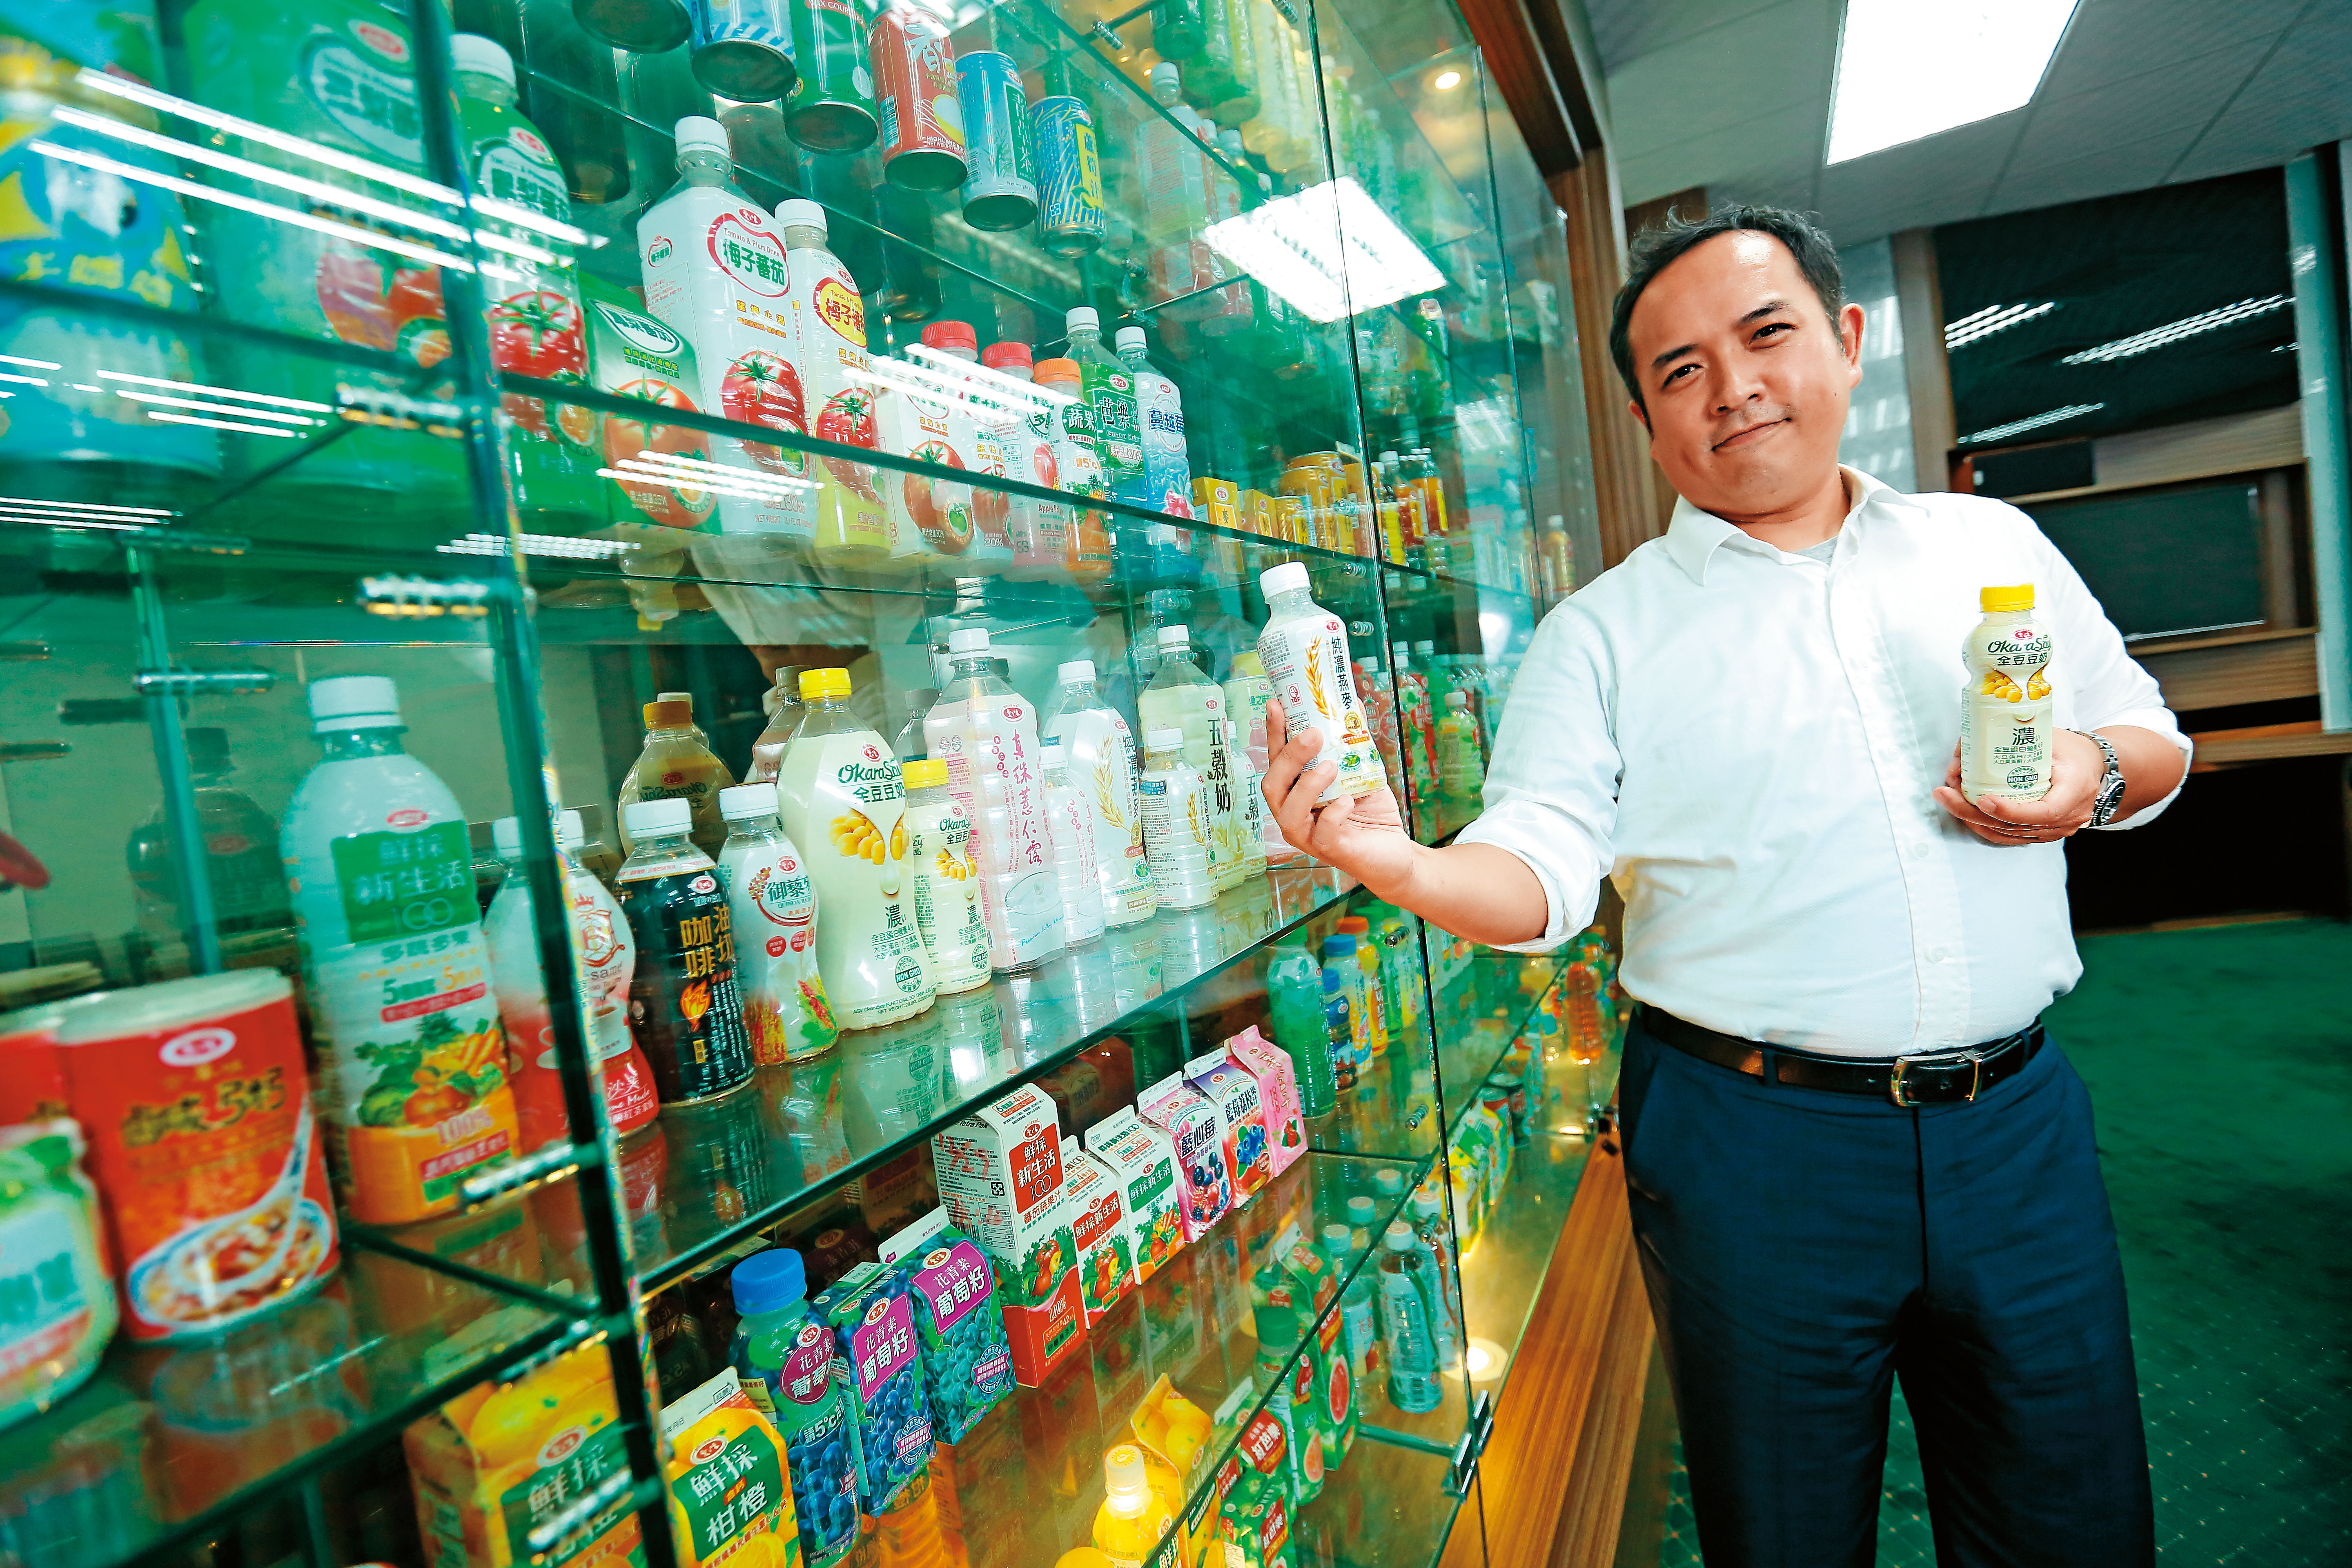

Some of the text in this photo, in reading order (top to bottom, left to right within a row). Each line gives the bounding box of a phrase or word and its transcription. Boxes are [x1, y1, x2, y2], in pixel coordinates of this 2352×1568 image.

[927, 136, 956, 146] HIGHLAND
[1013, 93, 1032, 174] 青草茶
[724, 227, 745, 242] Tomato
[752, 240, 766, 251] Plum
[766, 246, 780, 257] Drink
[723, 238, 785, 286] 梅子蕃茄
[831, 290, 846, 300] Tomato
[736, 300, 785, 326] 望梅止渴
[1066, 408, 1096, 432] 蔬果
[1107, 430, 1127, 440] Guava
[1148, 408, 1185, 437] 蔓越莓
[1038, 503, 1053, 513] Apple
[984, 538, 1003, 548] 30%
[1332, 636, 1353, 710] 純濃燕麥
[1996, 652, 2047, 666] 全豆豆奶
[853, 782, 905, 803] 全豆豆奶
[946, 830, 971, 845] 全豆豆
[354, 860, 466, 905] 新生活
[777, 899, 800, 909] QUINOA
[680, 917, 716, 979] 咖啡
[713, 903, 734, 963] 油切
[896, 967, 921, 983] NON GMO
[1024, 1136, 1047, 1163] 鮮採
[1016, 1148, 1056, 1188] 新生活
[1130, 1163, 1171, 1202] 鮮採新生活
[1029, 1174, 1051, 1202] 100
[1076, 1196, 1118, 1240] 鮮採新生活
[933, 1257, 971, 1289] 花青素
[935, 1265, 985, 1320] 葡萄籽
[1048, 1295, 1067, 1323] 100%
[865, 1315, 897, 1353] 花青素
[798, 1336, 833, 1372] 花青素
[862, 1327, 909, 1387] 葡萄籽
[528, 1443, 608, 1513] 鮮採
[690, 1443, 758, 1508] 鮮採
[706, 1481, 768, 1547] 柑橙
